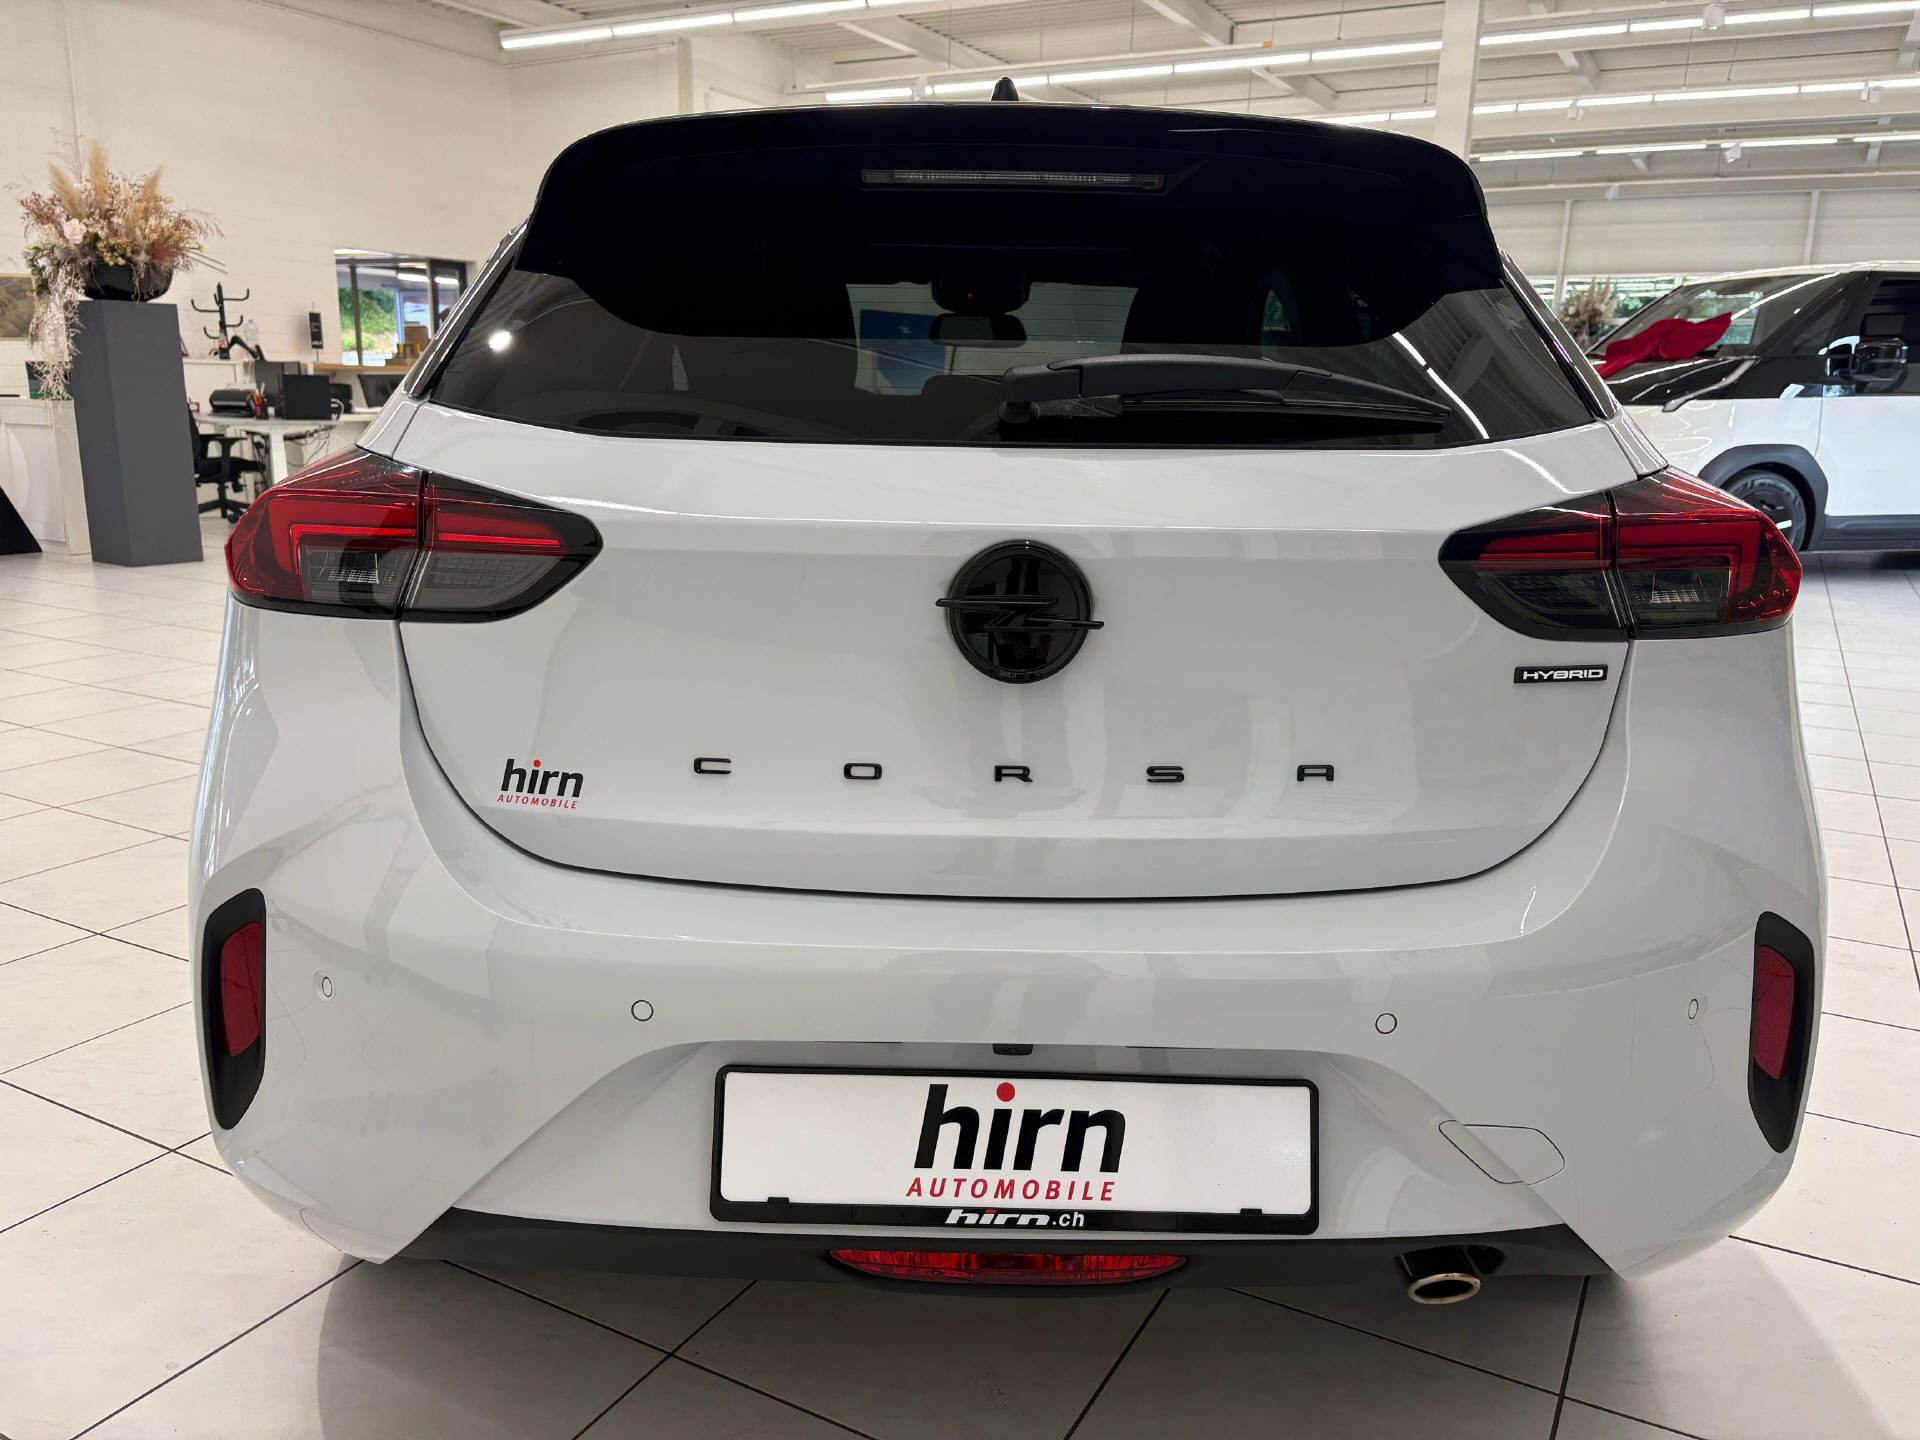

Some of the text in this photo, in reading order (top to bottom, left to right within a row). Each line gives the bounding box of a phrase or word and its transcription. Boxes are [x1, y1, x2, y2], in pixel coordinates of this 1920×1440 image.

[1522, 669, 1604, 680] HYBRID
[500, 758, 584, 798] hirn
[693, 757, 1335, 783] CORSA
[497, 794, 579, 809] AUTOMOBILE
[913, 1081, 1126, 1173] hirn
[905, 1177, 1116, 1201] AUTOMOBILE
[945, 1208, 1085, 1227] hirn.ch
